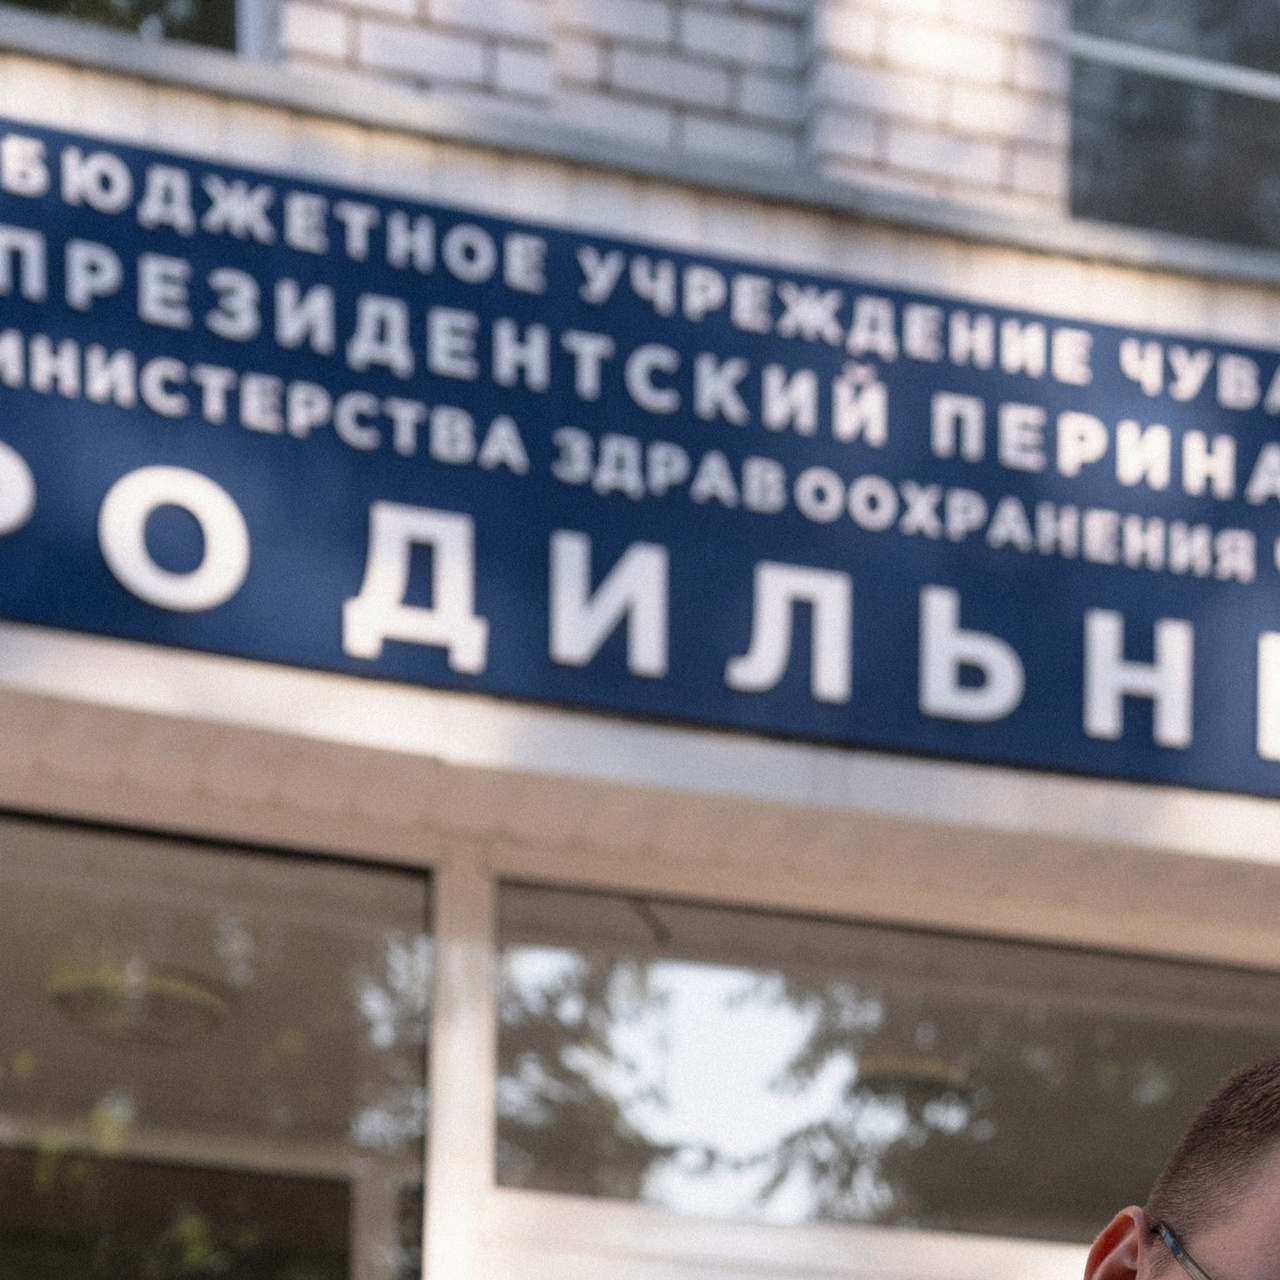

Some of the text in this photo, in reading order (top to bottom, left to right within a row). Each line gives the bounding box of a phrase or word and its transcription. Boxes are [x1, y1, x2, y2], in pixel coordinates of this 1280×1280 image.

[0, 132, 547, 294] БЮДЖЕТНОЕ
[577, 245, 1095, 388] УЧРЕЖДЕНИЕ
[0, 223, 890, 449] ПРЕЗИДЕНТСКИЙ
[550, 428, 1257, 585] ЗДРАВООХРАНЕНИЯ
